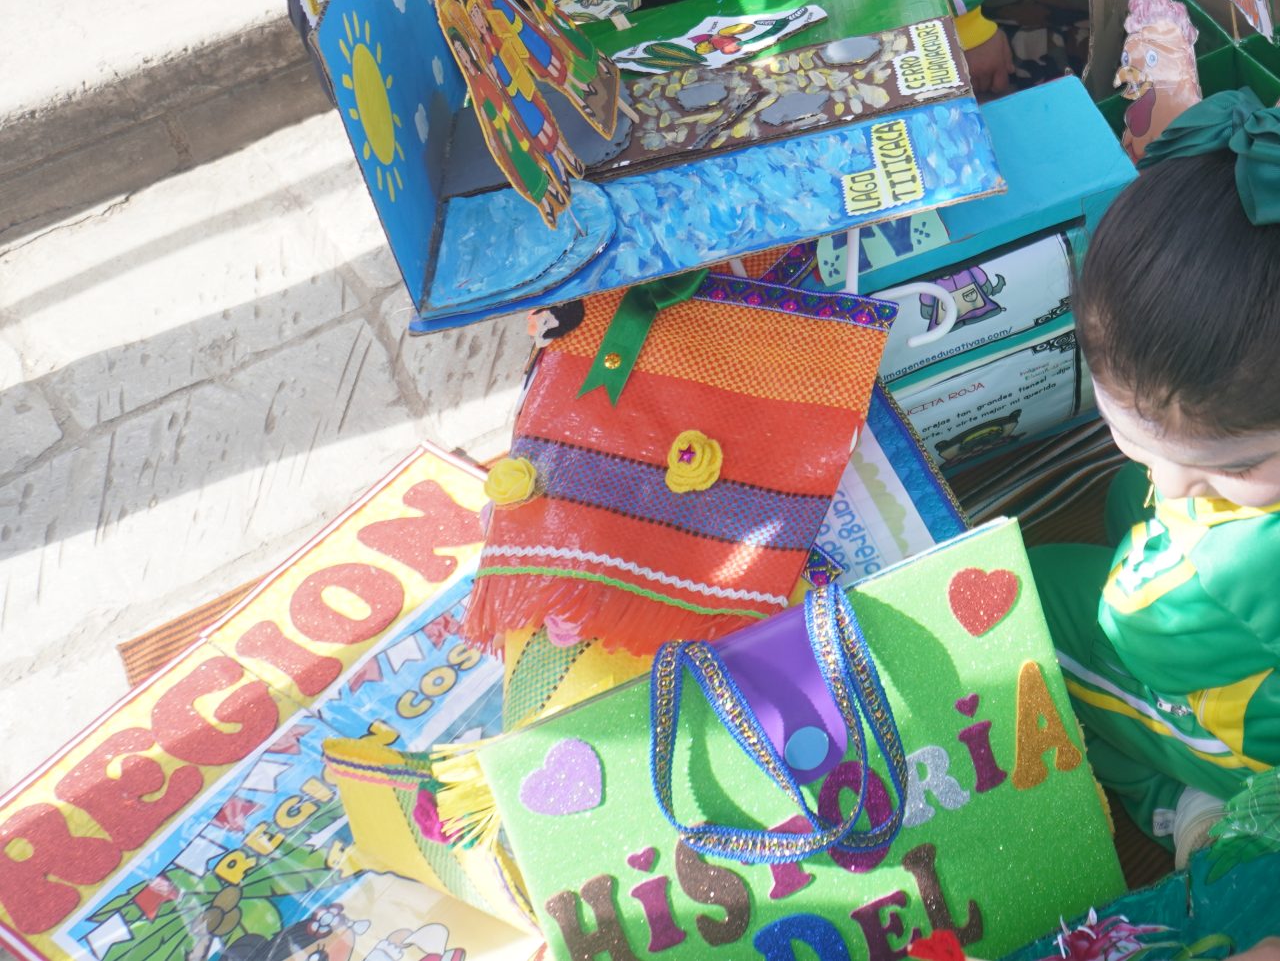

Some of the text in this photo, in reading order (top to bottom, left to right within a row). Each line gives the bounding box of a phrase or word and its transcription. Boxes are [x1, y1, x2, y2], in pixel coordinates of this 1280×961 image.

[900, 55, 926, 91] CERRO
[873, 121, 918, 202] TITICACA
[850, 171, 882, 213] LAGO
[948, 382, 985, 401] ROJA
[0, 479, 489, 935] REGION
